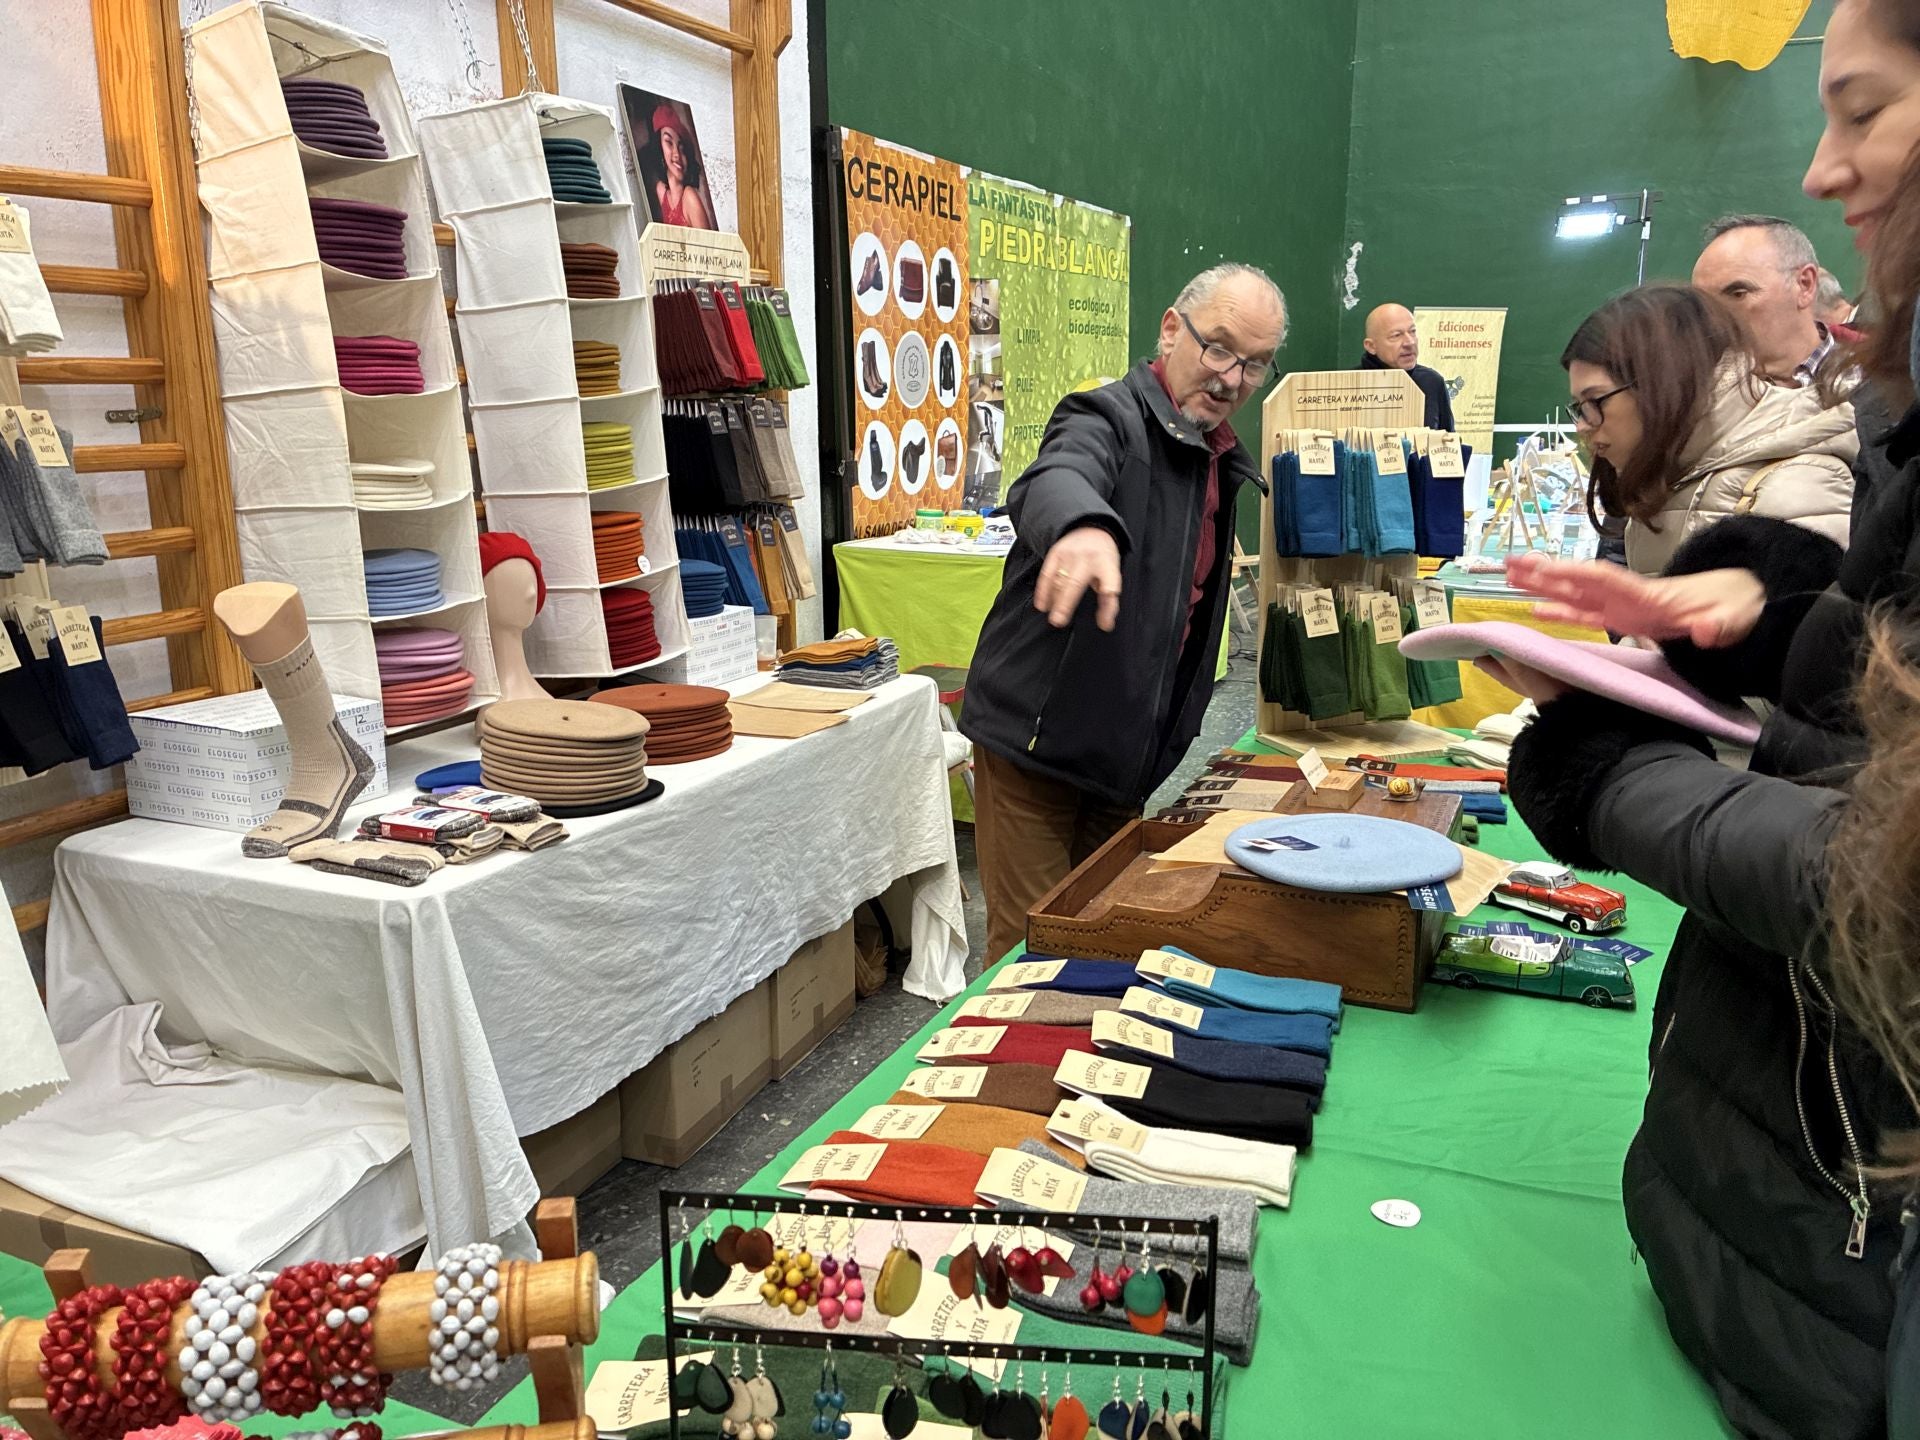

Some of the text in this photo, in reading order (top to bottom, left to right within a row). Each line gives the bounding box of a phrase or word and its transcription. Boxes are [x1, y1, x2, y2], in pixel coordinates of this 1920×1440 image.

[847, 156, 961, 222] CERAPIEL
[968, 183, 988, 206] LA
[653, 248, 693, 263] CARRETERA
[693, 253, 699, 265] Y
[1068, 298, 1117, 318] ecológico y
[1068, 319, 1123, 339] biodegradable
[1438, 320, 1485, 332] Ediciones
[1016, 327, 1041, 345] LIMPIA
[1429, 337, 1493, 349] Emilianenses
[1015, 377, 1034, 393] PULE
[1297, 395, 1341, 405] CARRETERA
[1343, 395, 1349, 403] Y
[1013, 423, 1046, 441] PROTEG
[60, 623, 90, 637] CARRETERA
[70, 641, 89, 651] MANTA
[337, 704, 371, 718] ELOSEG
[356, 721, 385, 735] ELOSEG
[163, 742, 200, 754] ELOSEGUI
[207, 748, 247, 760] ELOSEGUI
[144, 761, 180, 773] ELOSEGUI
[187, 767, 225, 779] ELOSEGUI
[233, 769, 277, 782] ELOSEGUI
[167, 785, 204, 797] ELOSEGUI
[211, 792, 251, 803] ELOSEGUI
[149, 803, 185, 816] ELOSEGUI
[192, 810, 230, 823] ELOSEGUI
[237, 815, 270, 826] OSEGUI
[1419, 886, 1438, 910] SEGUI
[1085, 1059, 1107, 1090] CARRETERA
[1079, 1109, 1102, 1138] CARRETERA
[1010, 1157, 1040, 1198] CARRETERA
[1031, 1178, 1041, 1186] Y
[1041, 1177, 1061, 1200] MANTA
[955, 1320, 967, 1330] Y
[968, 1317, 990, 1342] ANTA
[617, 1367, 656, 1426] CARRETERA
[643, 1389, 656, 1397] Y
